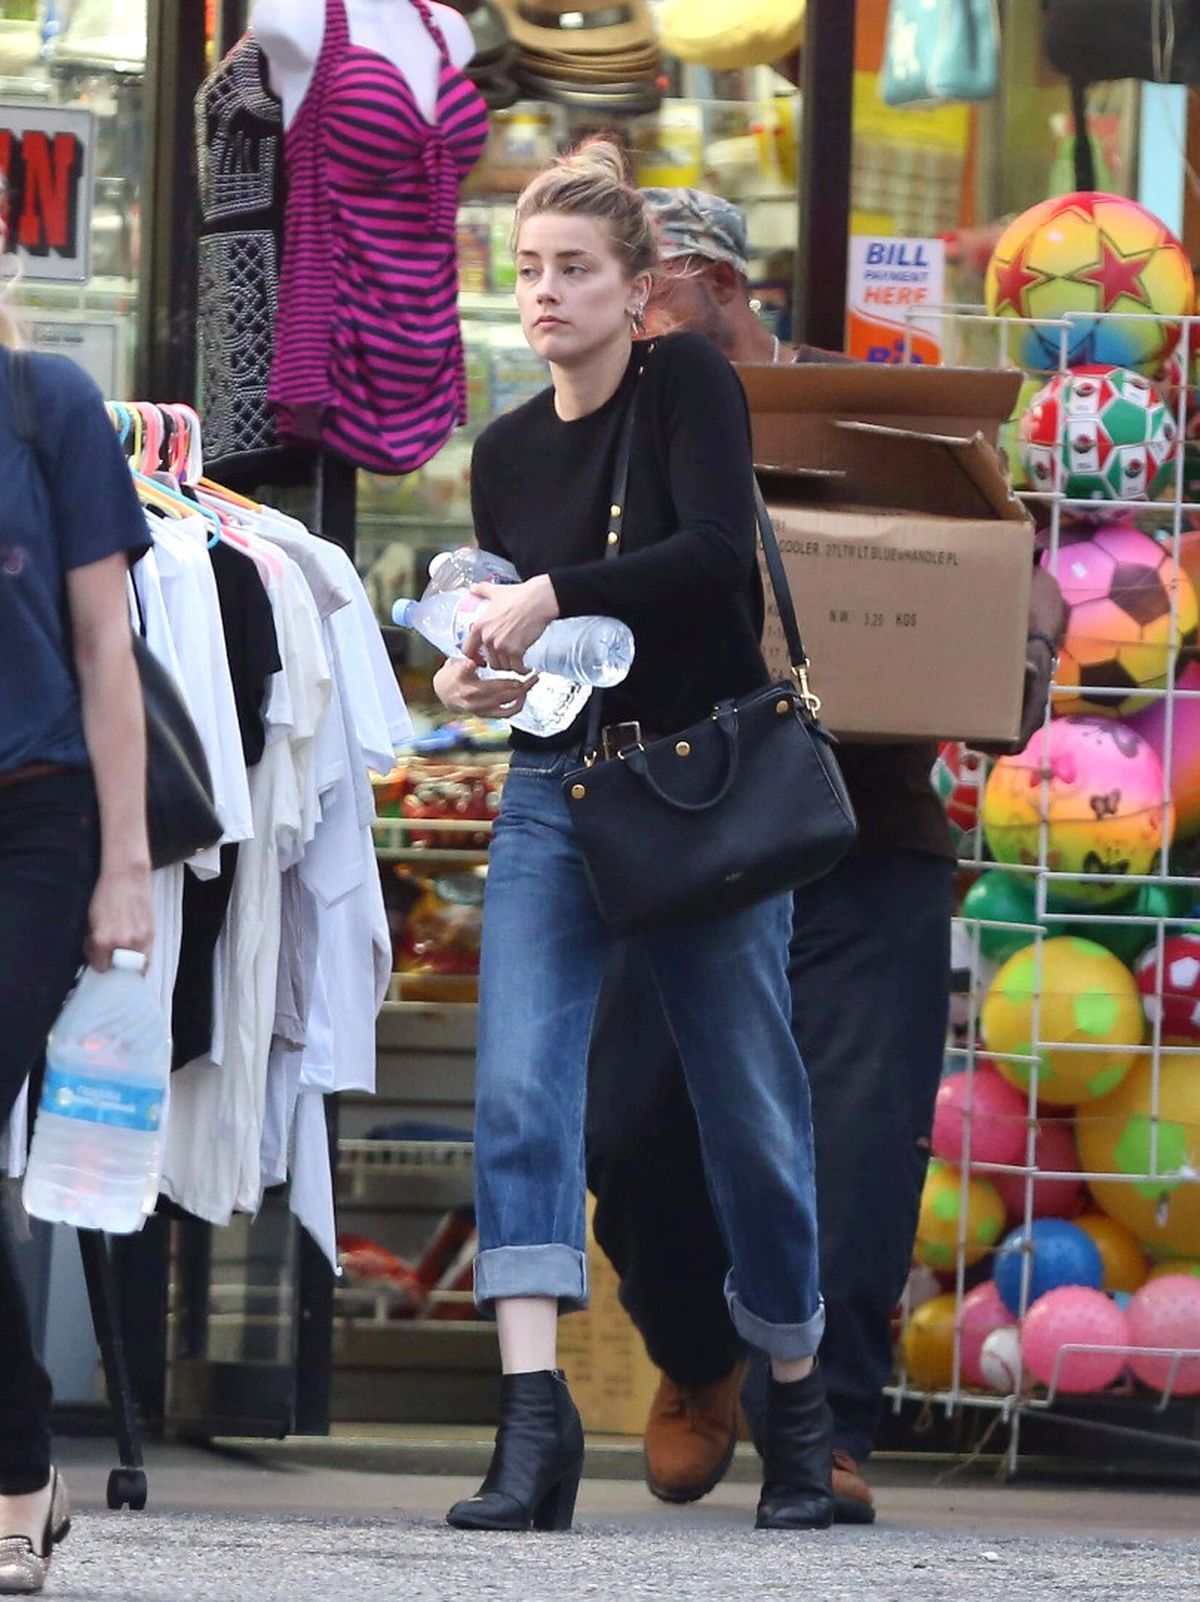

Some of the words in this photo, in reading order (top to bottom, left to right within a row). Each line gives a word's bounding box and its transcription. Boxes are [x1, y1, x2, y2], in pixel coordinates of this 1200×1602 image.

[0, 128, 84, 259] N
[866, 242, 928, 267] BILL
[864, 286, 928, 305] HERE
